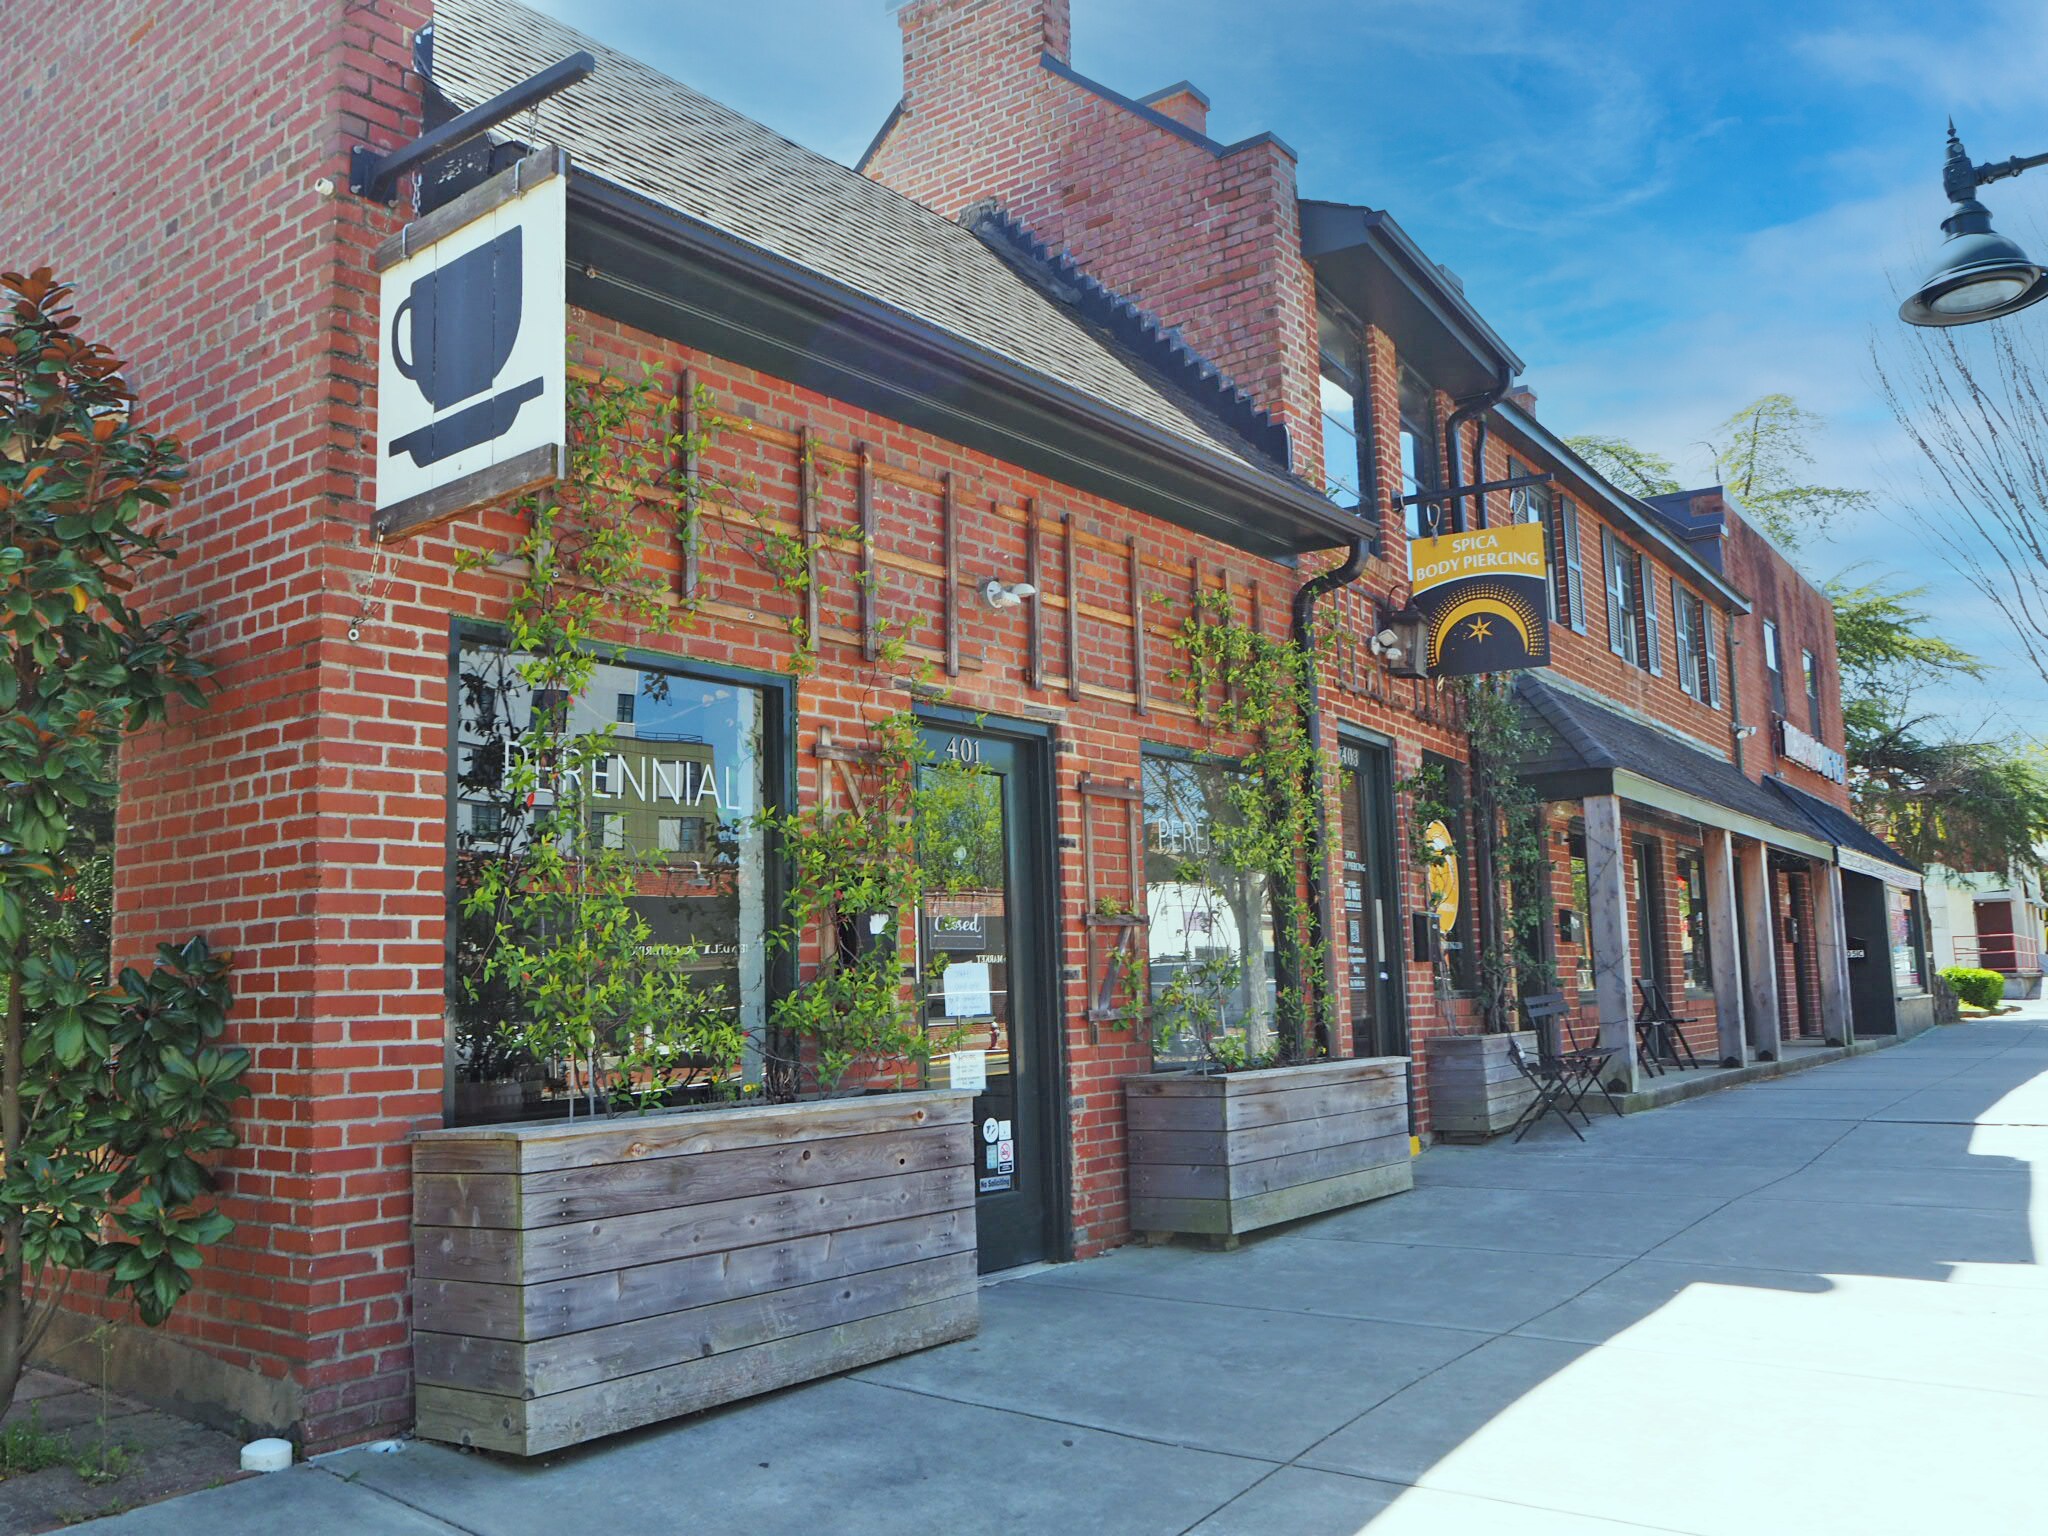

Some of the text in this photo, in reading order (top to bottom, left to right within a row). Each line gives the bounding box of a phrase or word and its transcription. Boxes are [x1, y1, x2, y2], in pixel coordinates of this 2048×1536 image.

[1452, 535, 1498, 553] SPICA
[1416, 551, 1539, 581] BODY PIERCING
[946, 737, 981, 763] 401
[935, 913, 982, 933] Cosed
